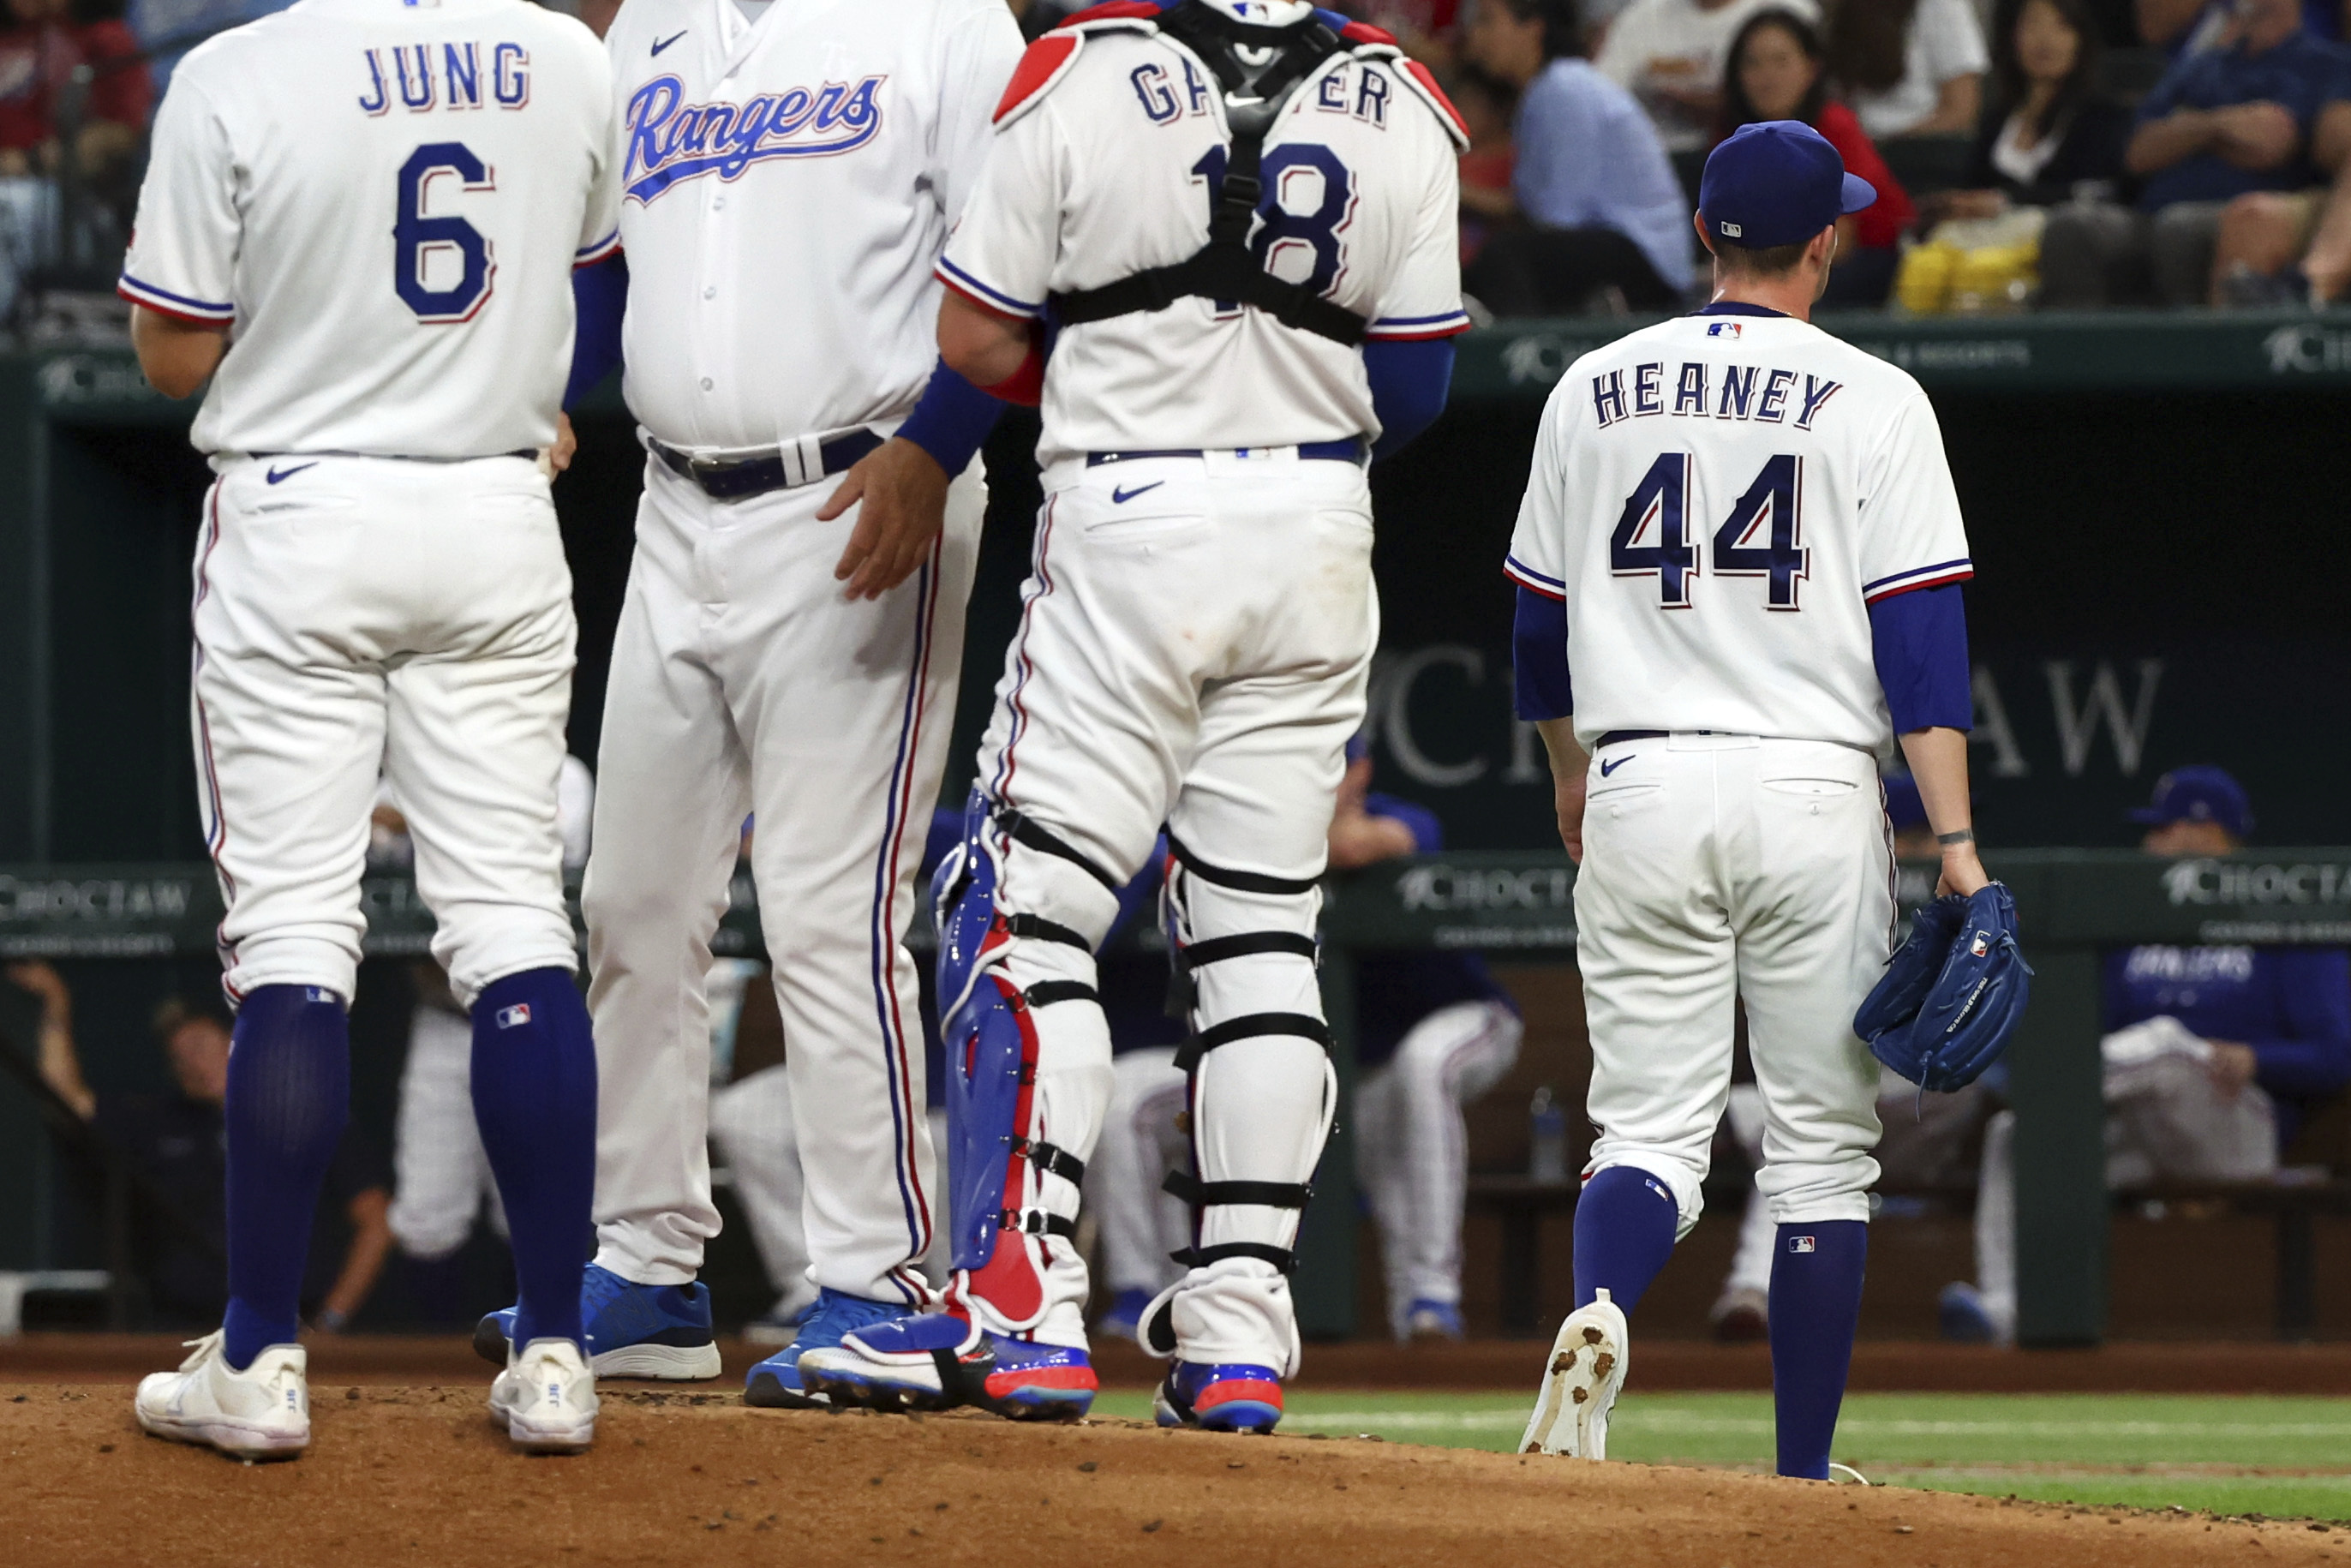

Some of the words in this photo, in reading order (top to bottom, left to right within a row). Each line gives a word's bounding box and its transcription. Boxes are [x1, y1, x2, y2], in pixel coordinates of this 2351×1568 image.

[358, 40, 530, 118] JUNG
[1129, 58, 1388, 132] GAER
[622, 71, 889, 209] Rangers
[392, 141, 498, 325] 6
[1591, 362, 1844, 431] HEANEY
[1609, 452, 1810, 613] 44
